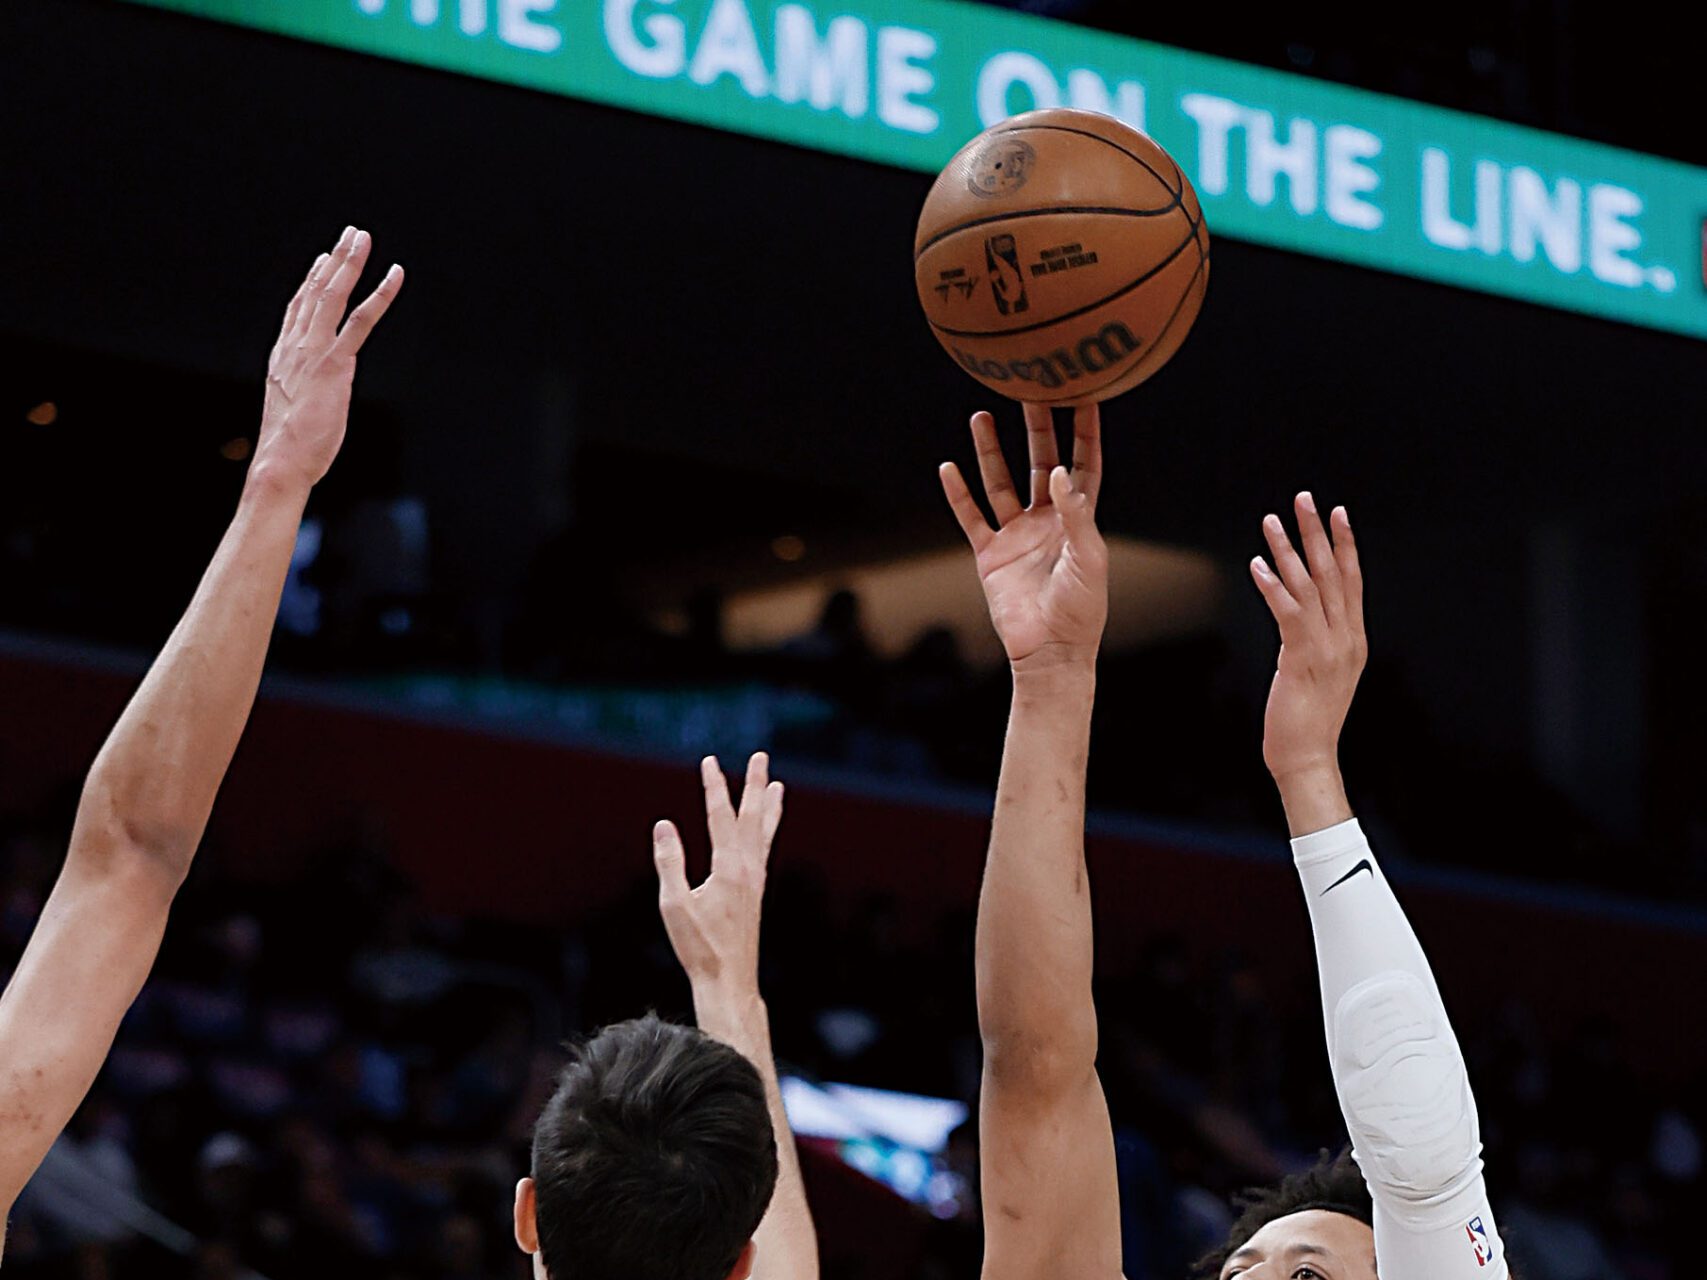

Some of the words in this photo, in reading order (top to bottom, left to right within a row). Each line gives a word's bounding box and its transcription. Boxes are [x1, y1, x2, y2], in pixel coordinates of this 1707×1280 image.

[603, 0, 940, 134] GAME
[1181, 93, 1383, 230] THE
[1421, 147, 1677, 293] LINE.
